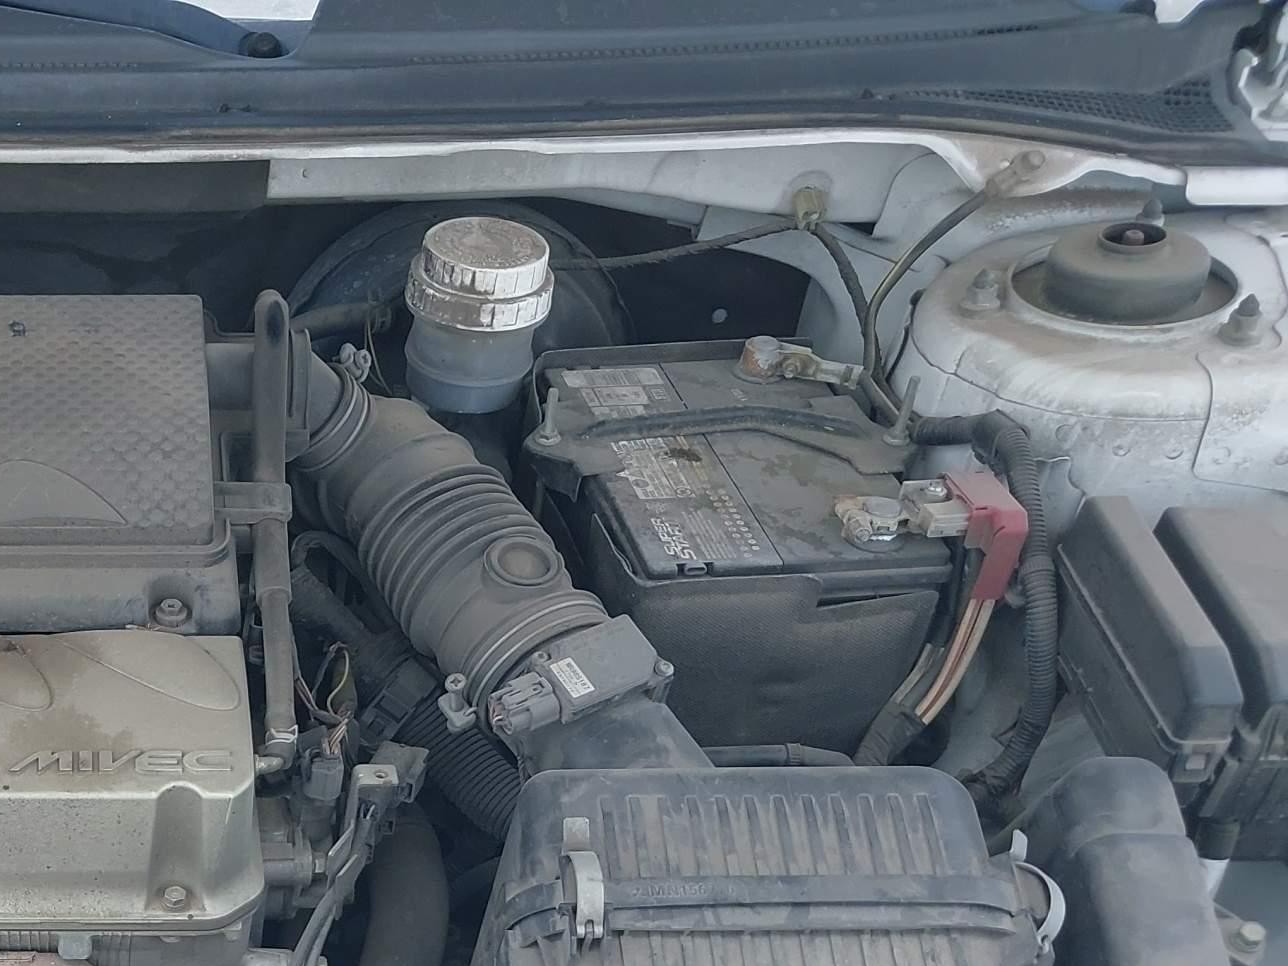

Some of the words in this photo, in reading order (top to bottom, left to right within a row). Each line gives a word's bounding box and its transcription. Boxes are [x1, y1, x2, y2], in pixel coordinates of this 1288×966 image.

[650, 517, 676, 555] SUPER
[665, 521, 697, 560] START
[9, 750, 233, 774] MIVEC
